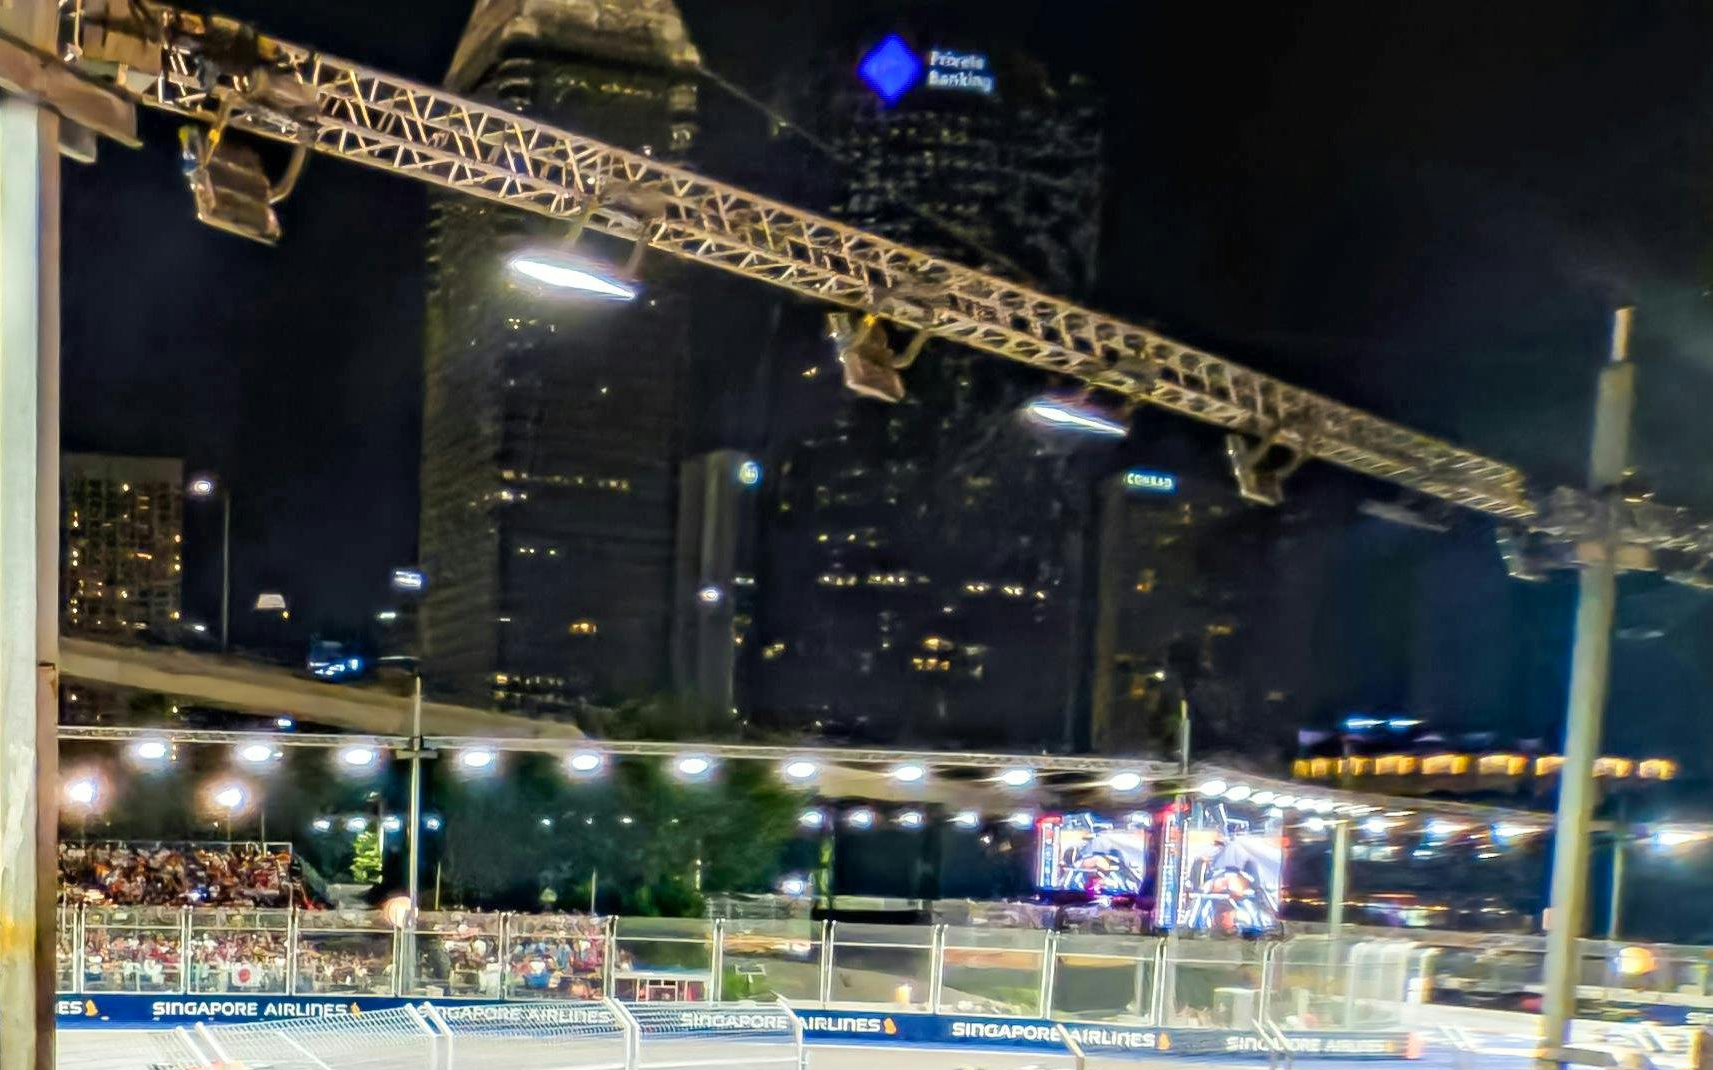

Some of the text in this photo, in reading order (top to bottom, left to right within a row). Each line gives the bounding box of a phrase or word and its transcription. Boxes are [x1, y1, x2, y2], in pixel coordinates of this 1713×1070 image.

[153, 1001, 348, 1017] SINGAPORE AIRLINES
[417, 1004, 521, 1020] SNGAPORE
[952, 1022, 1061, 1041] SINGAPORE
